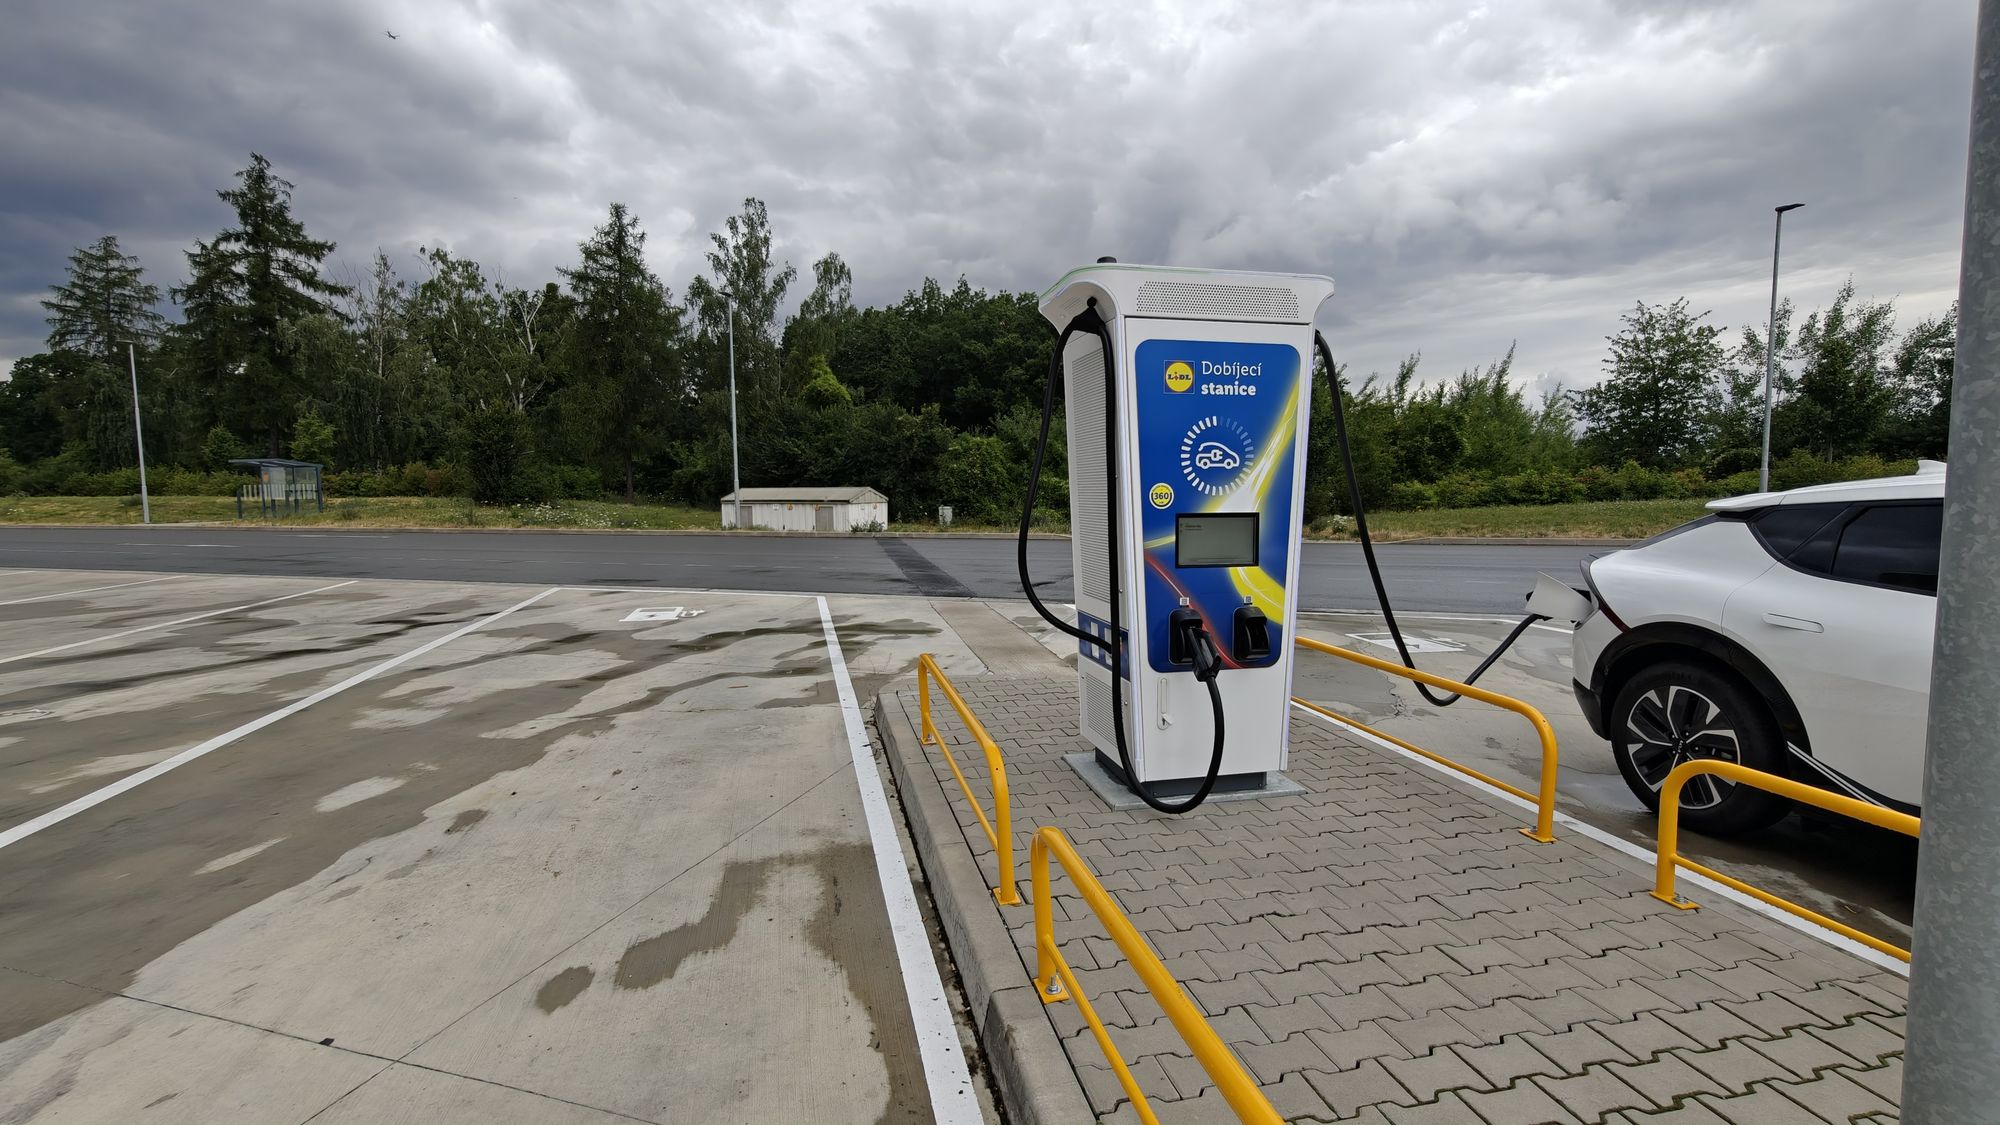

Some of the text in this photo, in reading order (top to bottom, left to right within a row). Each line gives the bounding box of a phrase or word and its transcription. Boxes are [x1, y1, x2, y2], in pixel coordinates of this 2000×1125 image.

[1201, 360, 1262, 379] Dobíjecí
[1201, 380, 1257, 396] stanice
[1153, 492, 1169, 500] 360
